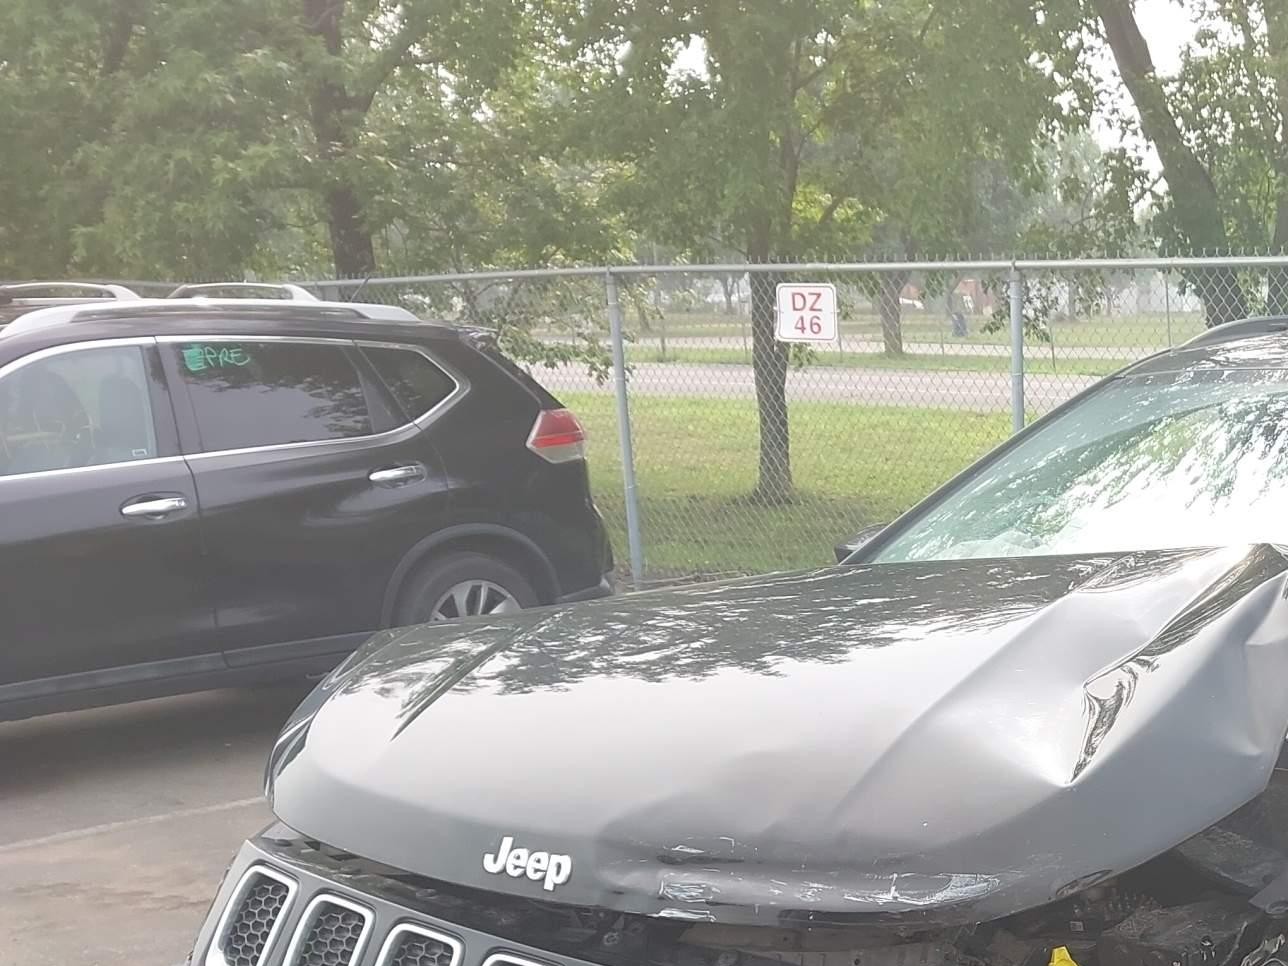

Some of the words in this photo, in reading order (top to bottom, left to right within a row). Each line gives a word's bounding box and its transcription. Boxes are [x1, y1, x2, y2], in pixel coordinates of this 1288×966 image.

[791, 292, 823, 312] DZ
[794, 315, 822, 335] 46
[204, 346, 251, 367] PRE
[483, 836, 572, 891] Jeep
